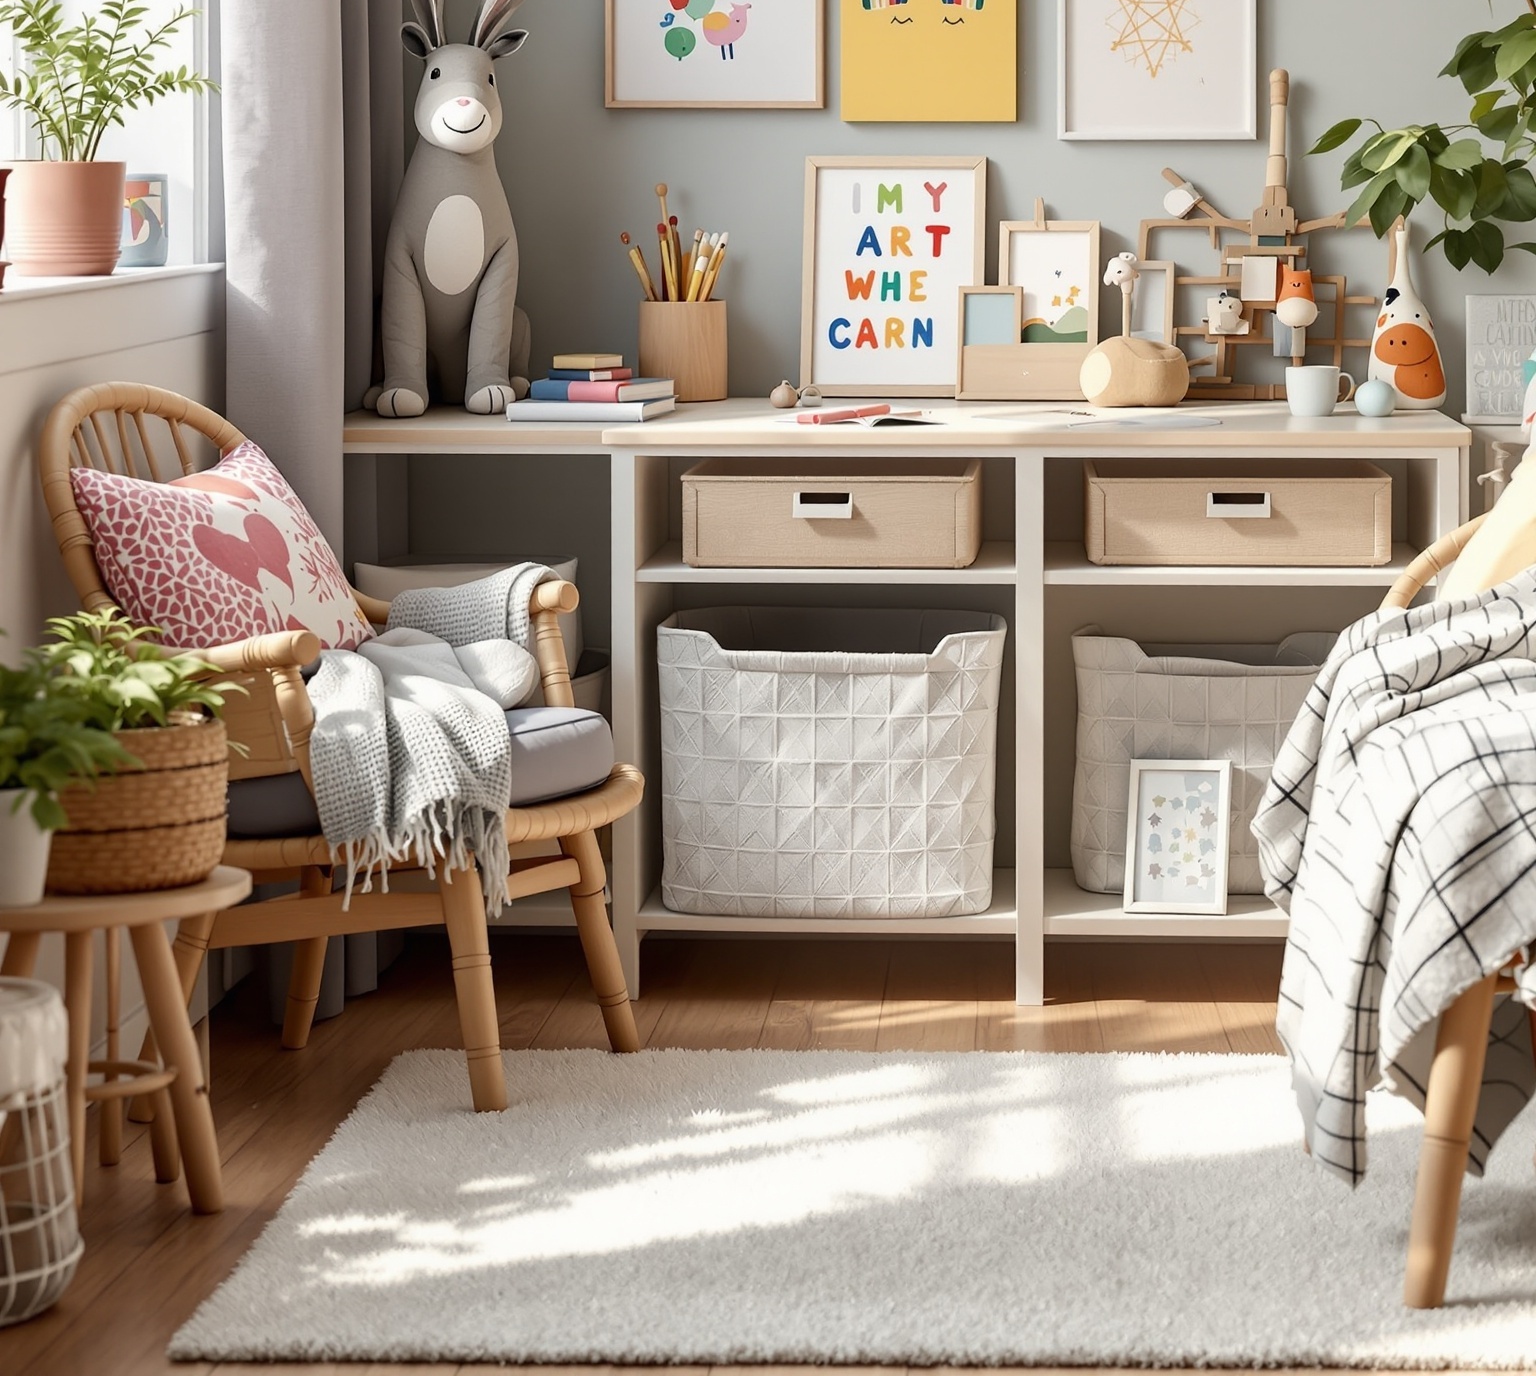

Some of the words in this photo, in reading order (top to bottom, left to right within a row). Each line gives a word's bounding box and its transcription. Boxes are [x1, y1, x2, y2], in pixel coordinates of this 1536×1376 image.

[856, 225, 951, 258] ART
[845, 270, 927, 302] WHE
[828, 317, 933, 349] CARN
